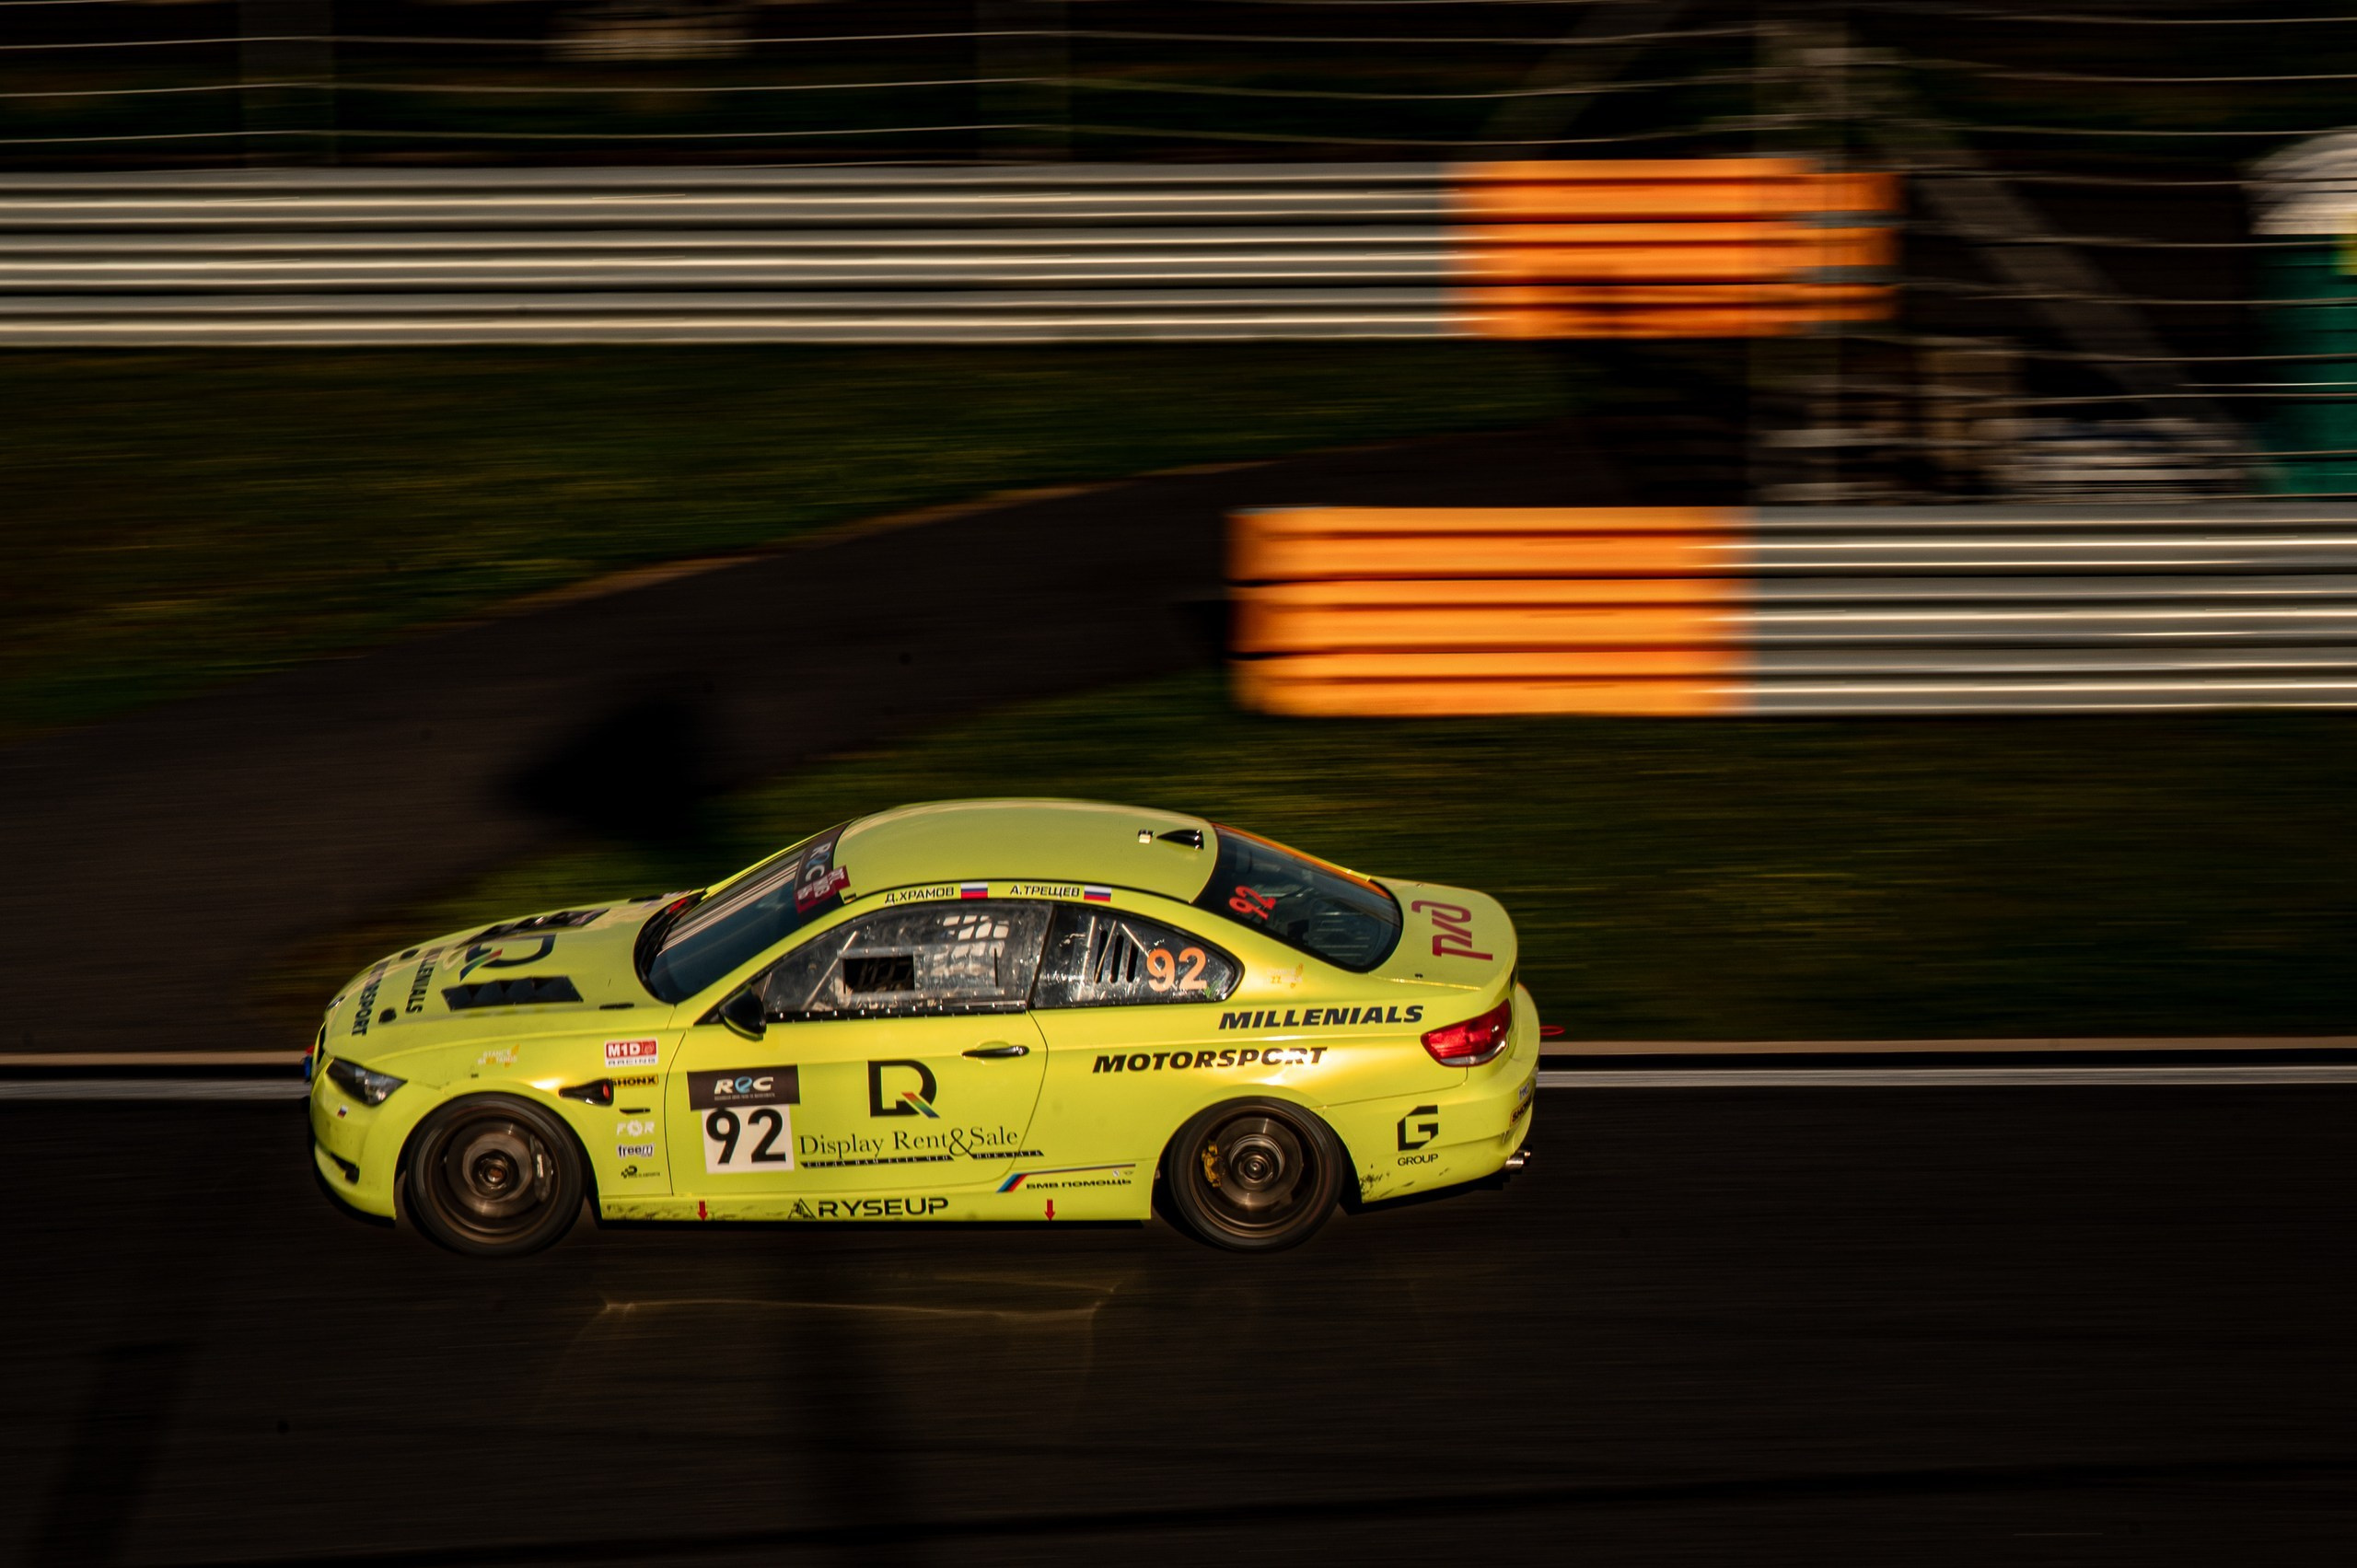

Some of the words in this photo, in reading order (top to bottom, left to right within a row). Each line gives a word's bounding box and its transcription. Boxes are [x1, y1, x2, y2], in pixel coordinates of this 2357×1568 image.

[885, 886, 954, 905] Д.ХРАМОВ
[1010, 884, 1080, 898] А.ТРЕЩЕВ
[1229, 885, 1276, 920] 92
[1146, 947, 1208, 993] 92
[1218, 1005, 1424, 1030] MILLENIALS
[608, 1041, 641, 1057] M1D
[1092, 1047, 1328, 1074] MOTORSPORT
[705, 1107, 787, 1166] 92
[798, 1132, 884, 1160] Display
[1397, 1153, 1439, 1167] GROUP
[1062, 1179, 1132, 1189] ПОМОЩЬ
[818, 1197, 949, 1217] RYSEUP
